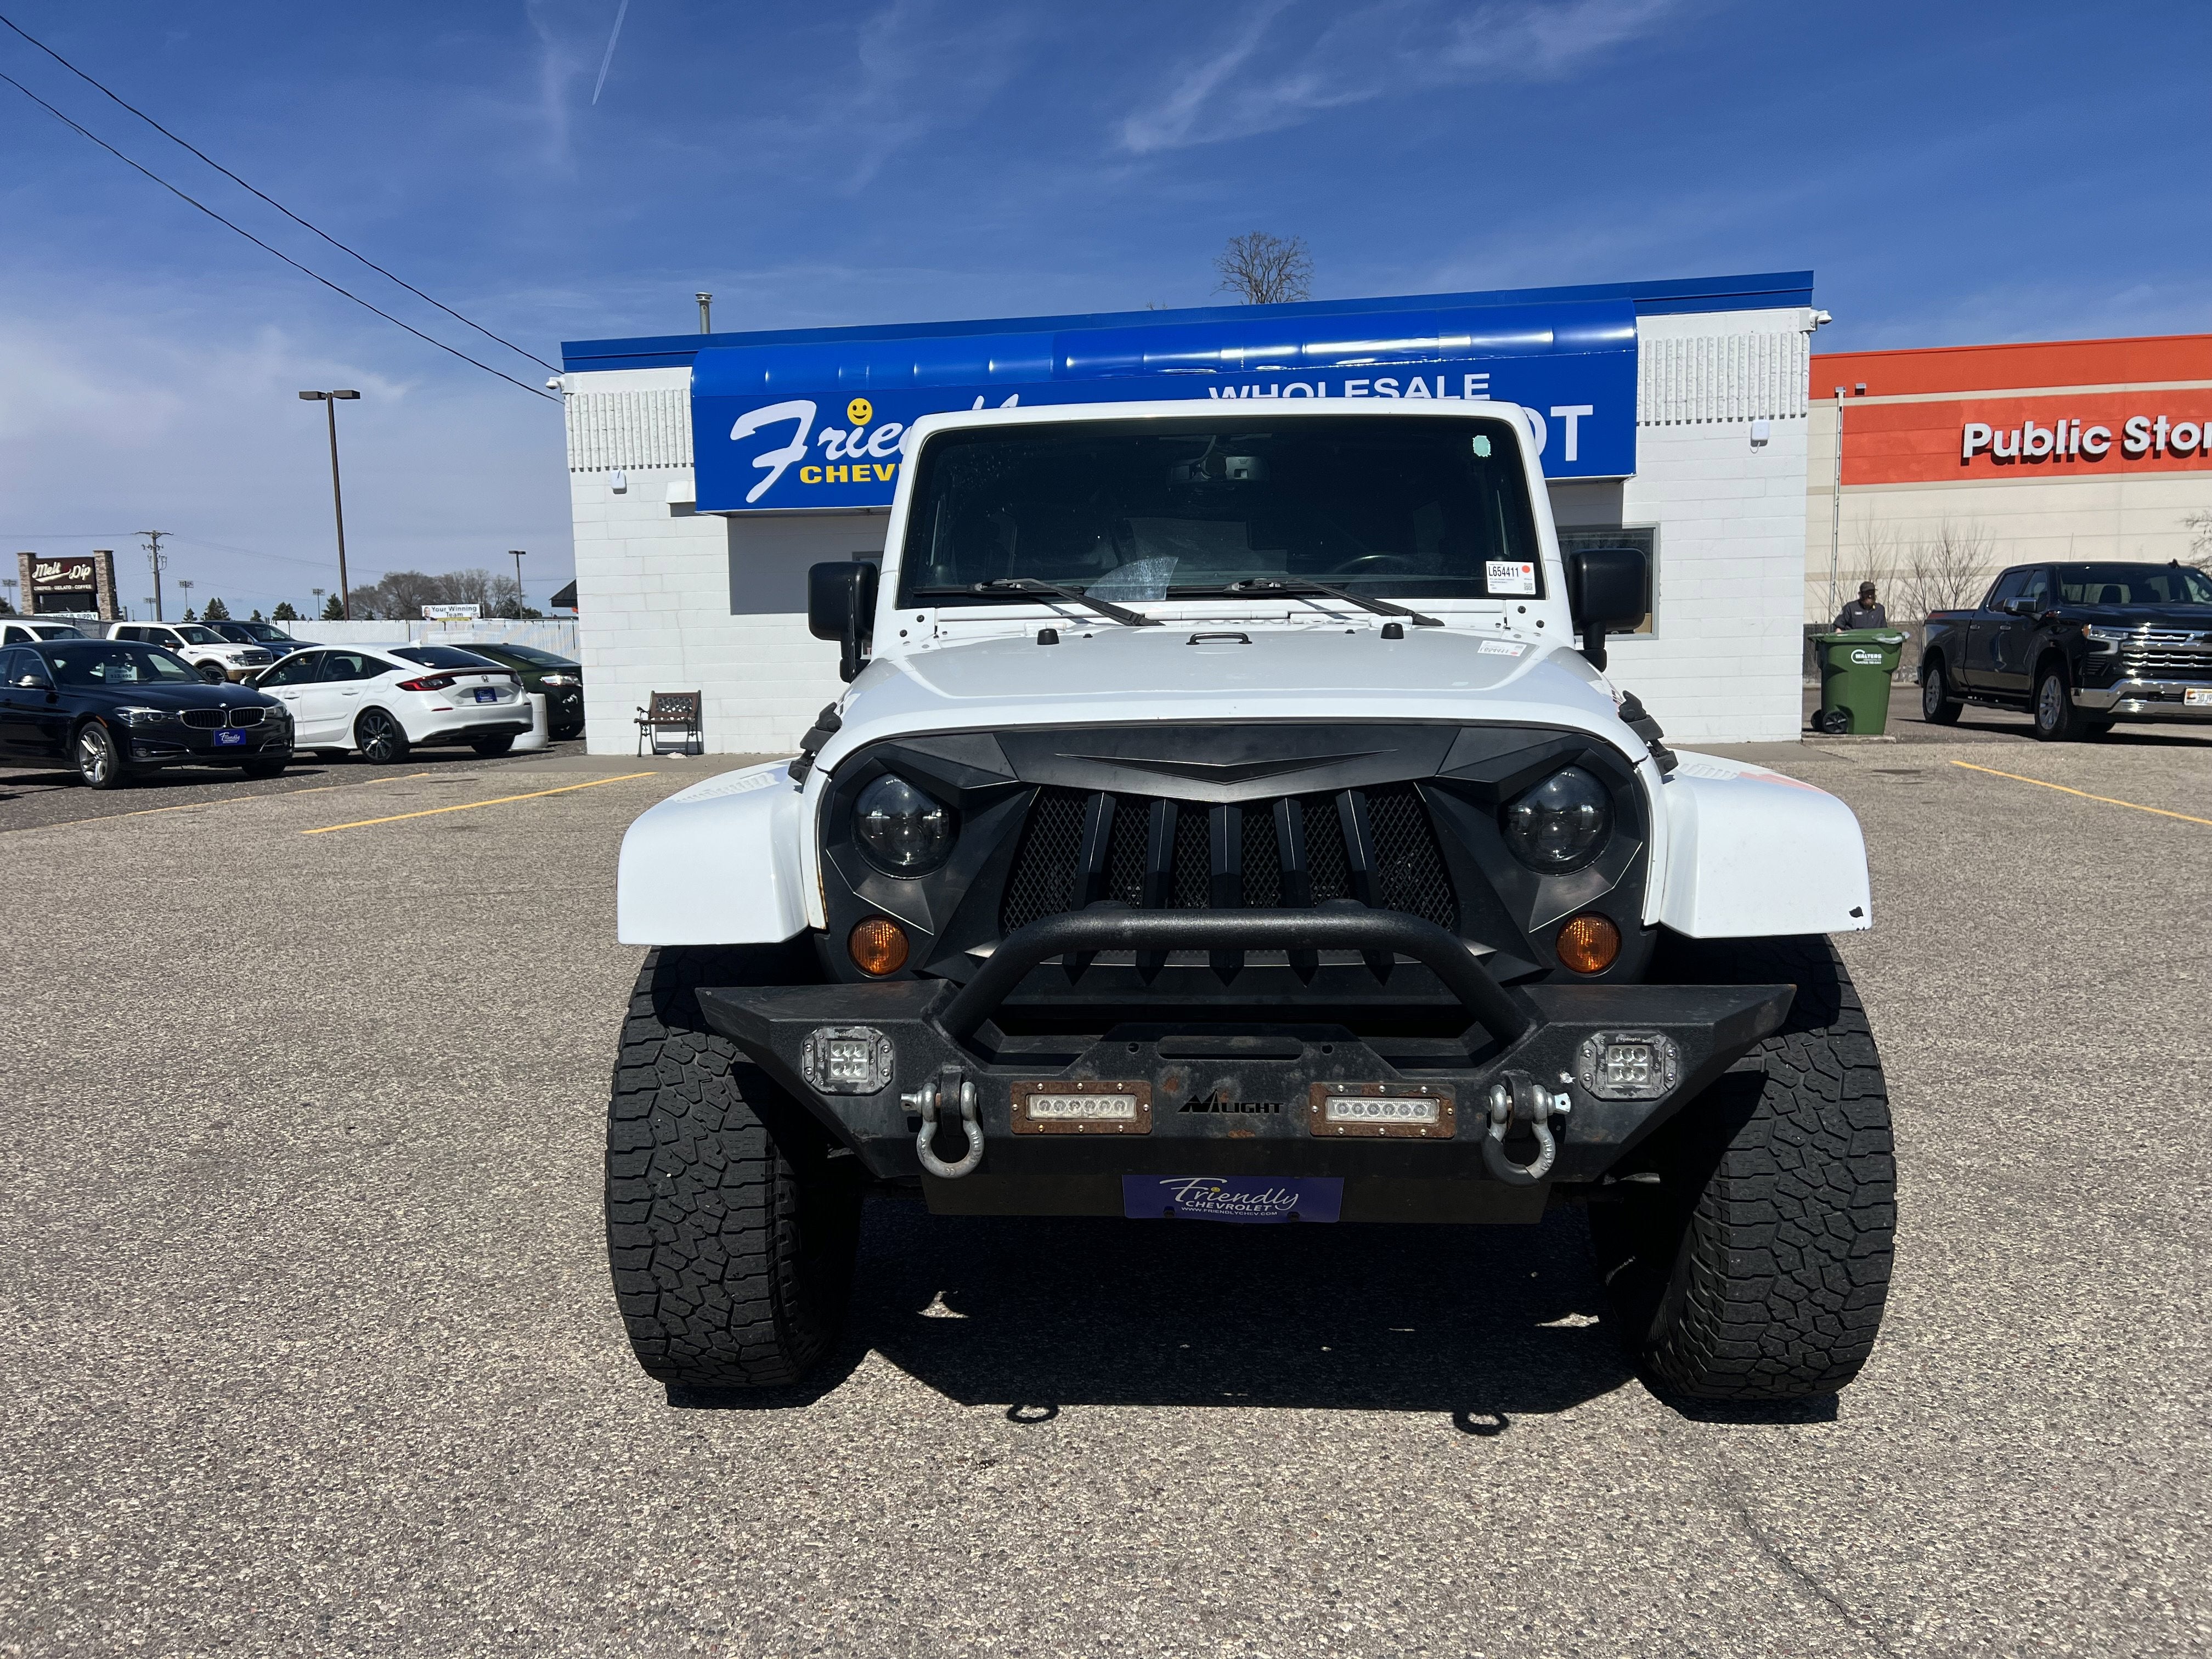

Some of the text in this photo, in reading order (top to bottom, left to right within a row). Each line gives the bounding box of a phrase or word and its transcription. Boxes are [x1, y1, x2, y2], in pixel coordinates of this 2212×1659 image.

[1963, 419, 2112, 458] Public
[800, 463, 901, 484] CHEV
[32, 562, 92, 580] Melt Dip
[1488, 566, 1519, 577] L654411
[1159, 1177, 1299, 1211] Friendly
[1181, 1206, 1278, 1216] WWW.FRIENDLYCHEV.COM
[1185, 1200, 1273, 1212] CHEVROLET
